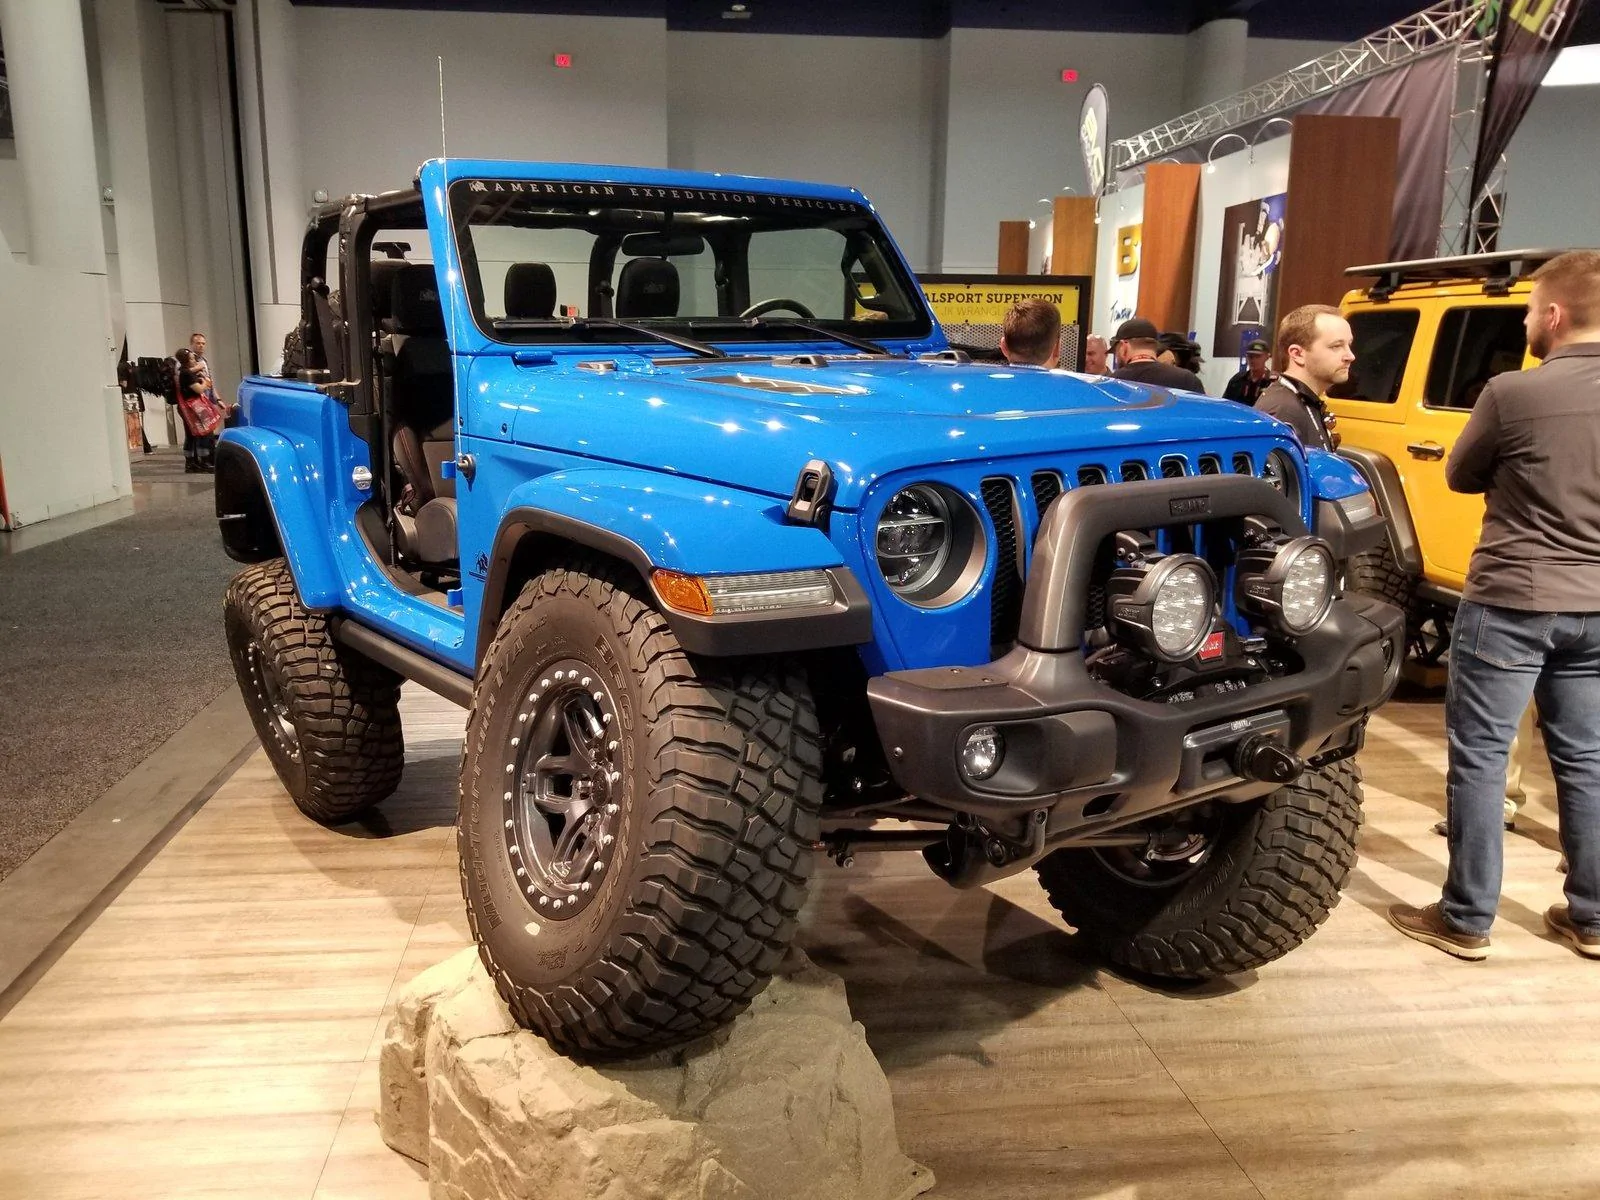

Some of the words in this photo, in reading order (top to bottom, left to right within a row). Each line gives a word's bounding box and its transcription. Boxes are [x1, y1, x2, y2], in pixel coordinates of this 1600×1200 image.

[494, 182, 615, 196] AMERICAN
[629, 187, 756, 203] EXPEDITION
[768, 196, 856, 212] VEHICLES
